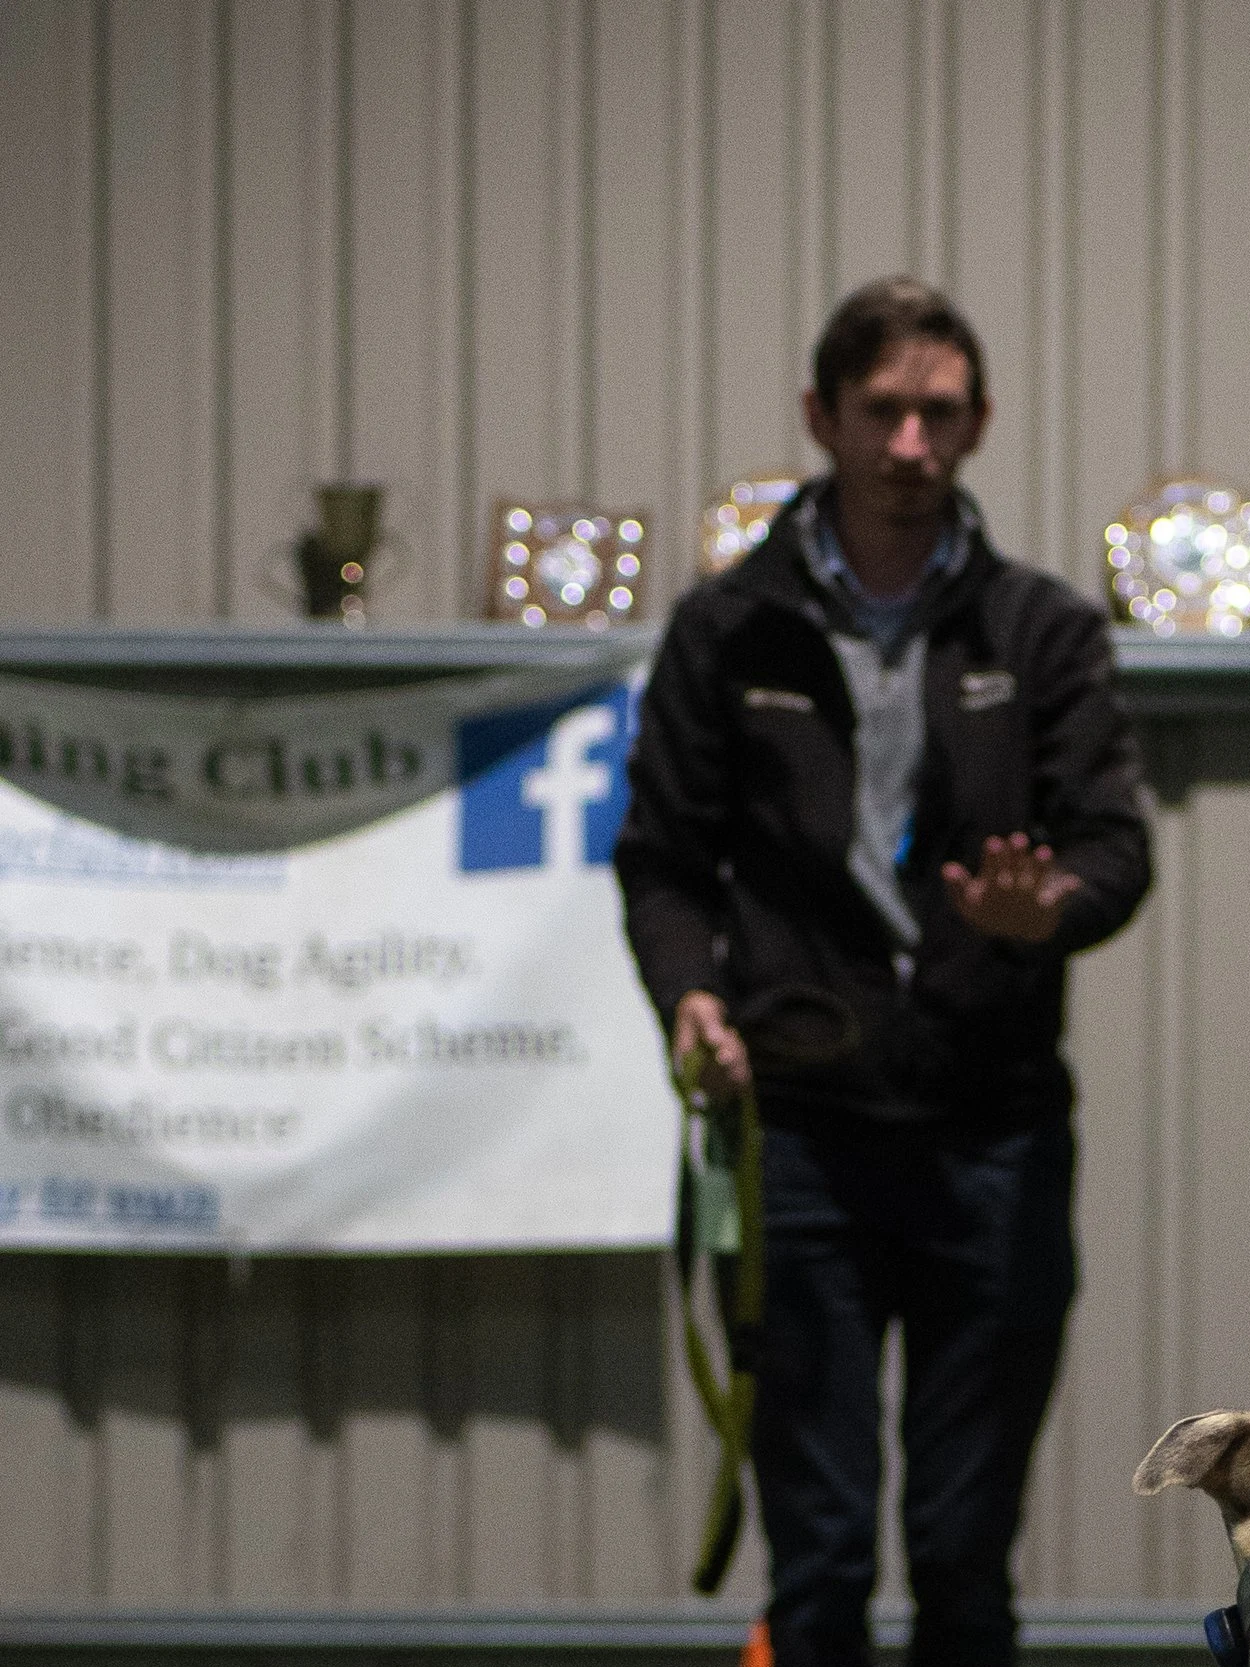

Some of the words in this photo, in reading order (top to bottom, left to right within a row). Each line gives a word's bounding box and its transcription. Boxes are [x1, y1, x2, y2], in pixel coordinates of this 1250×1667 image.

[206, 728, 424, 794] Club
[169, 933, 283, 989] Dog
[149, 1016, 348, 1070] Citizen
[7, 1082, 299, 1144] Obedience
